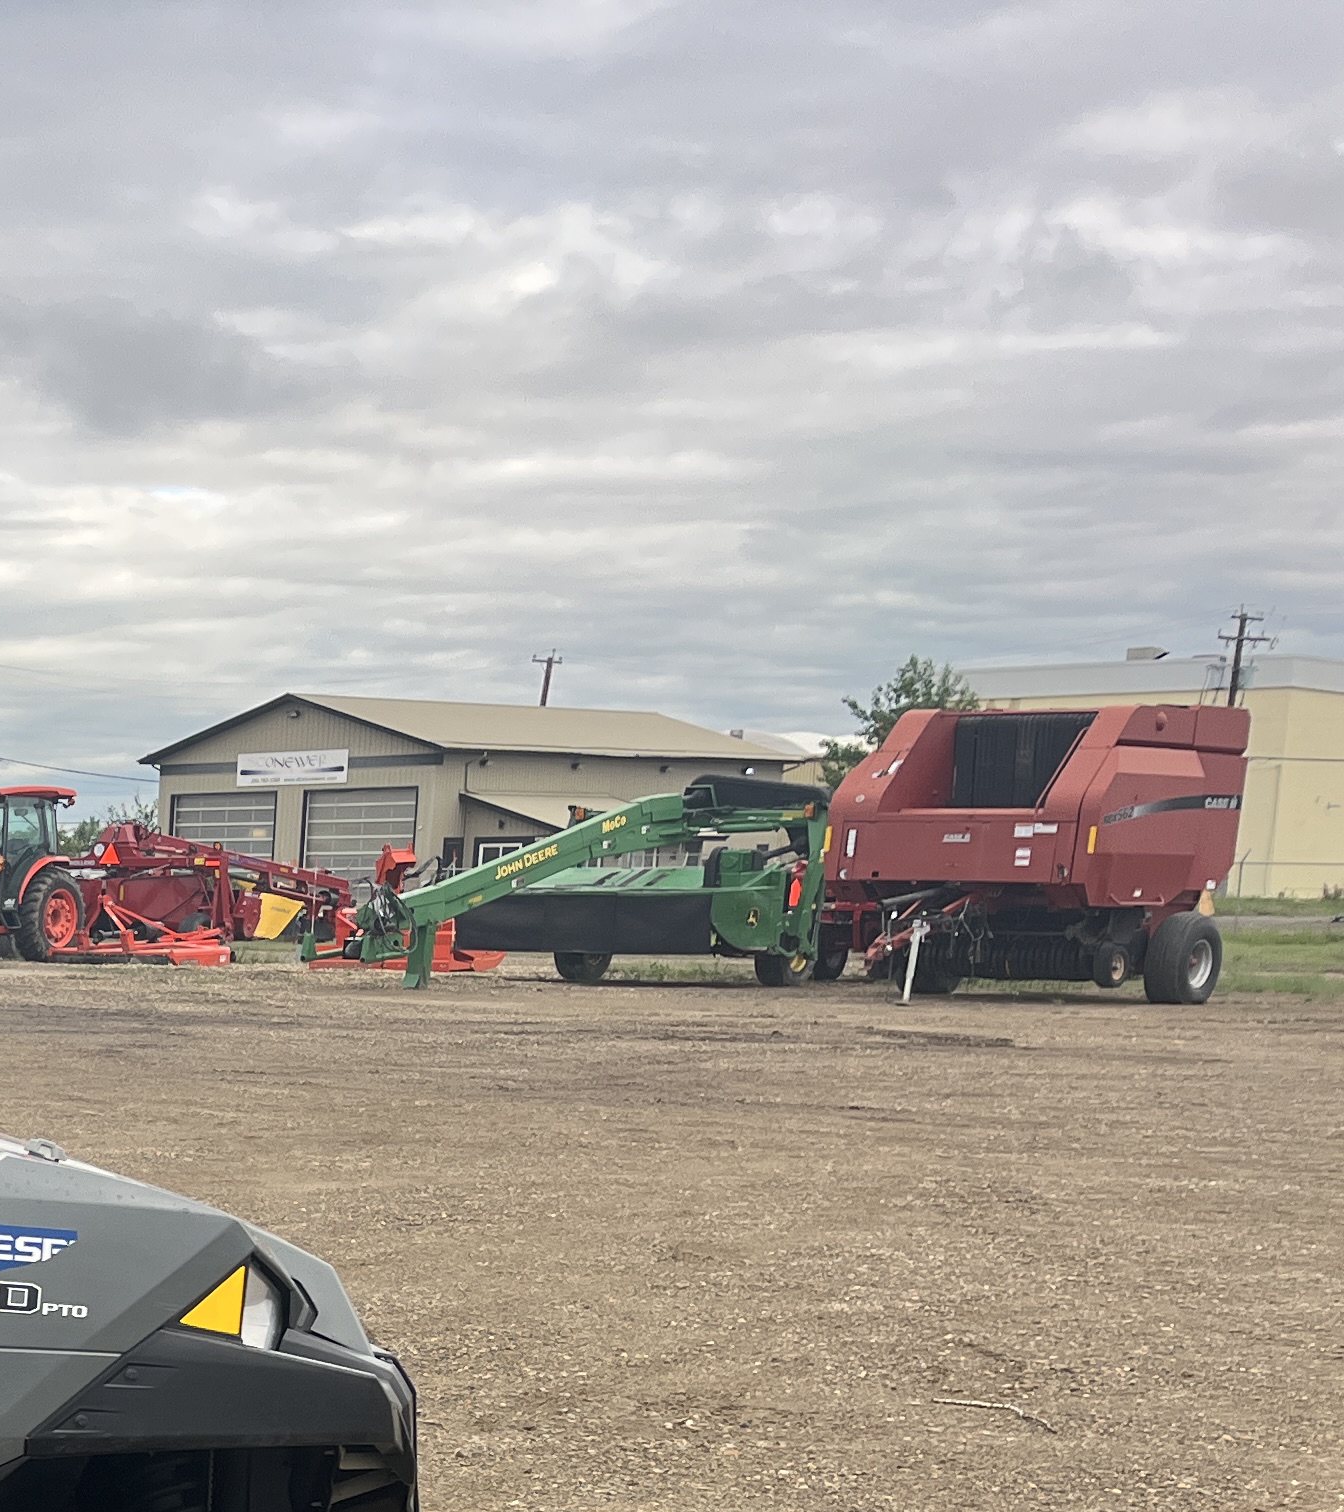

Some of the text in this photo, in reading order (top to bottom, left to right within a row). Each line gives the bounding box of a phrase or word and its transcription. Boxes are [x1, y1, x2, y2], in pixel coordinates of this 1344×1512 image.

[601, 815, 628, 834] MoCo
[495, 843, 559, 880] JOHN DEERE
[42, 1302, 89, 1319] PTO
